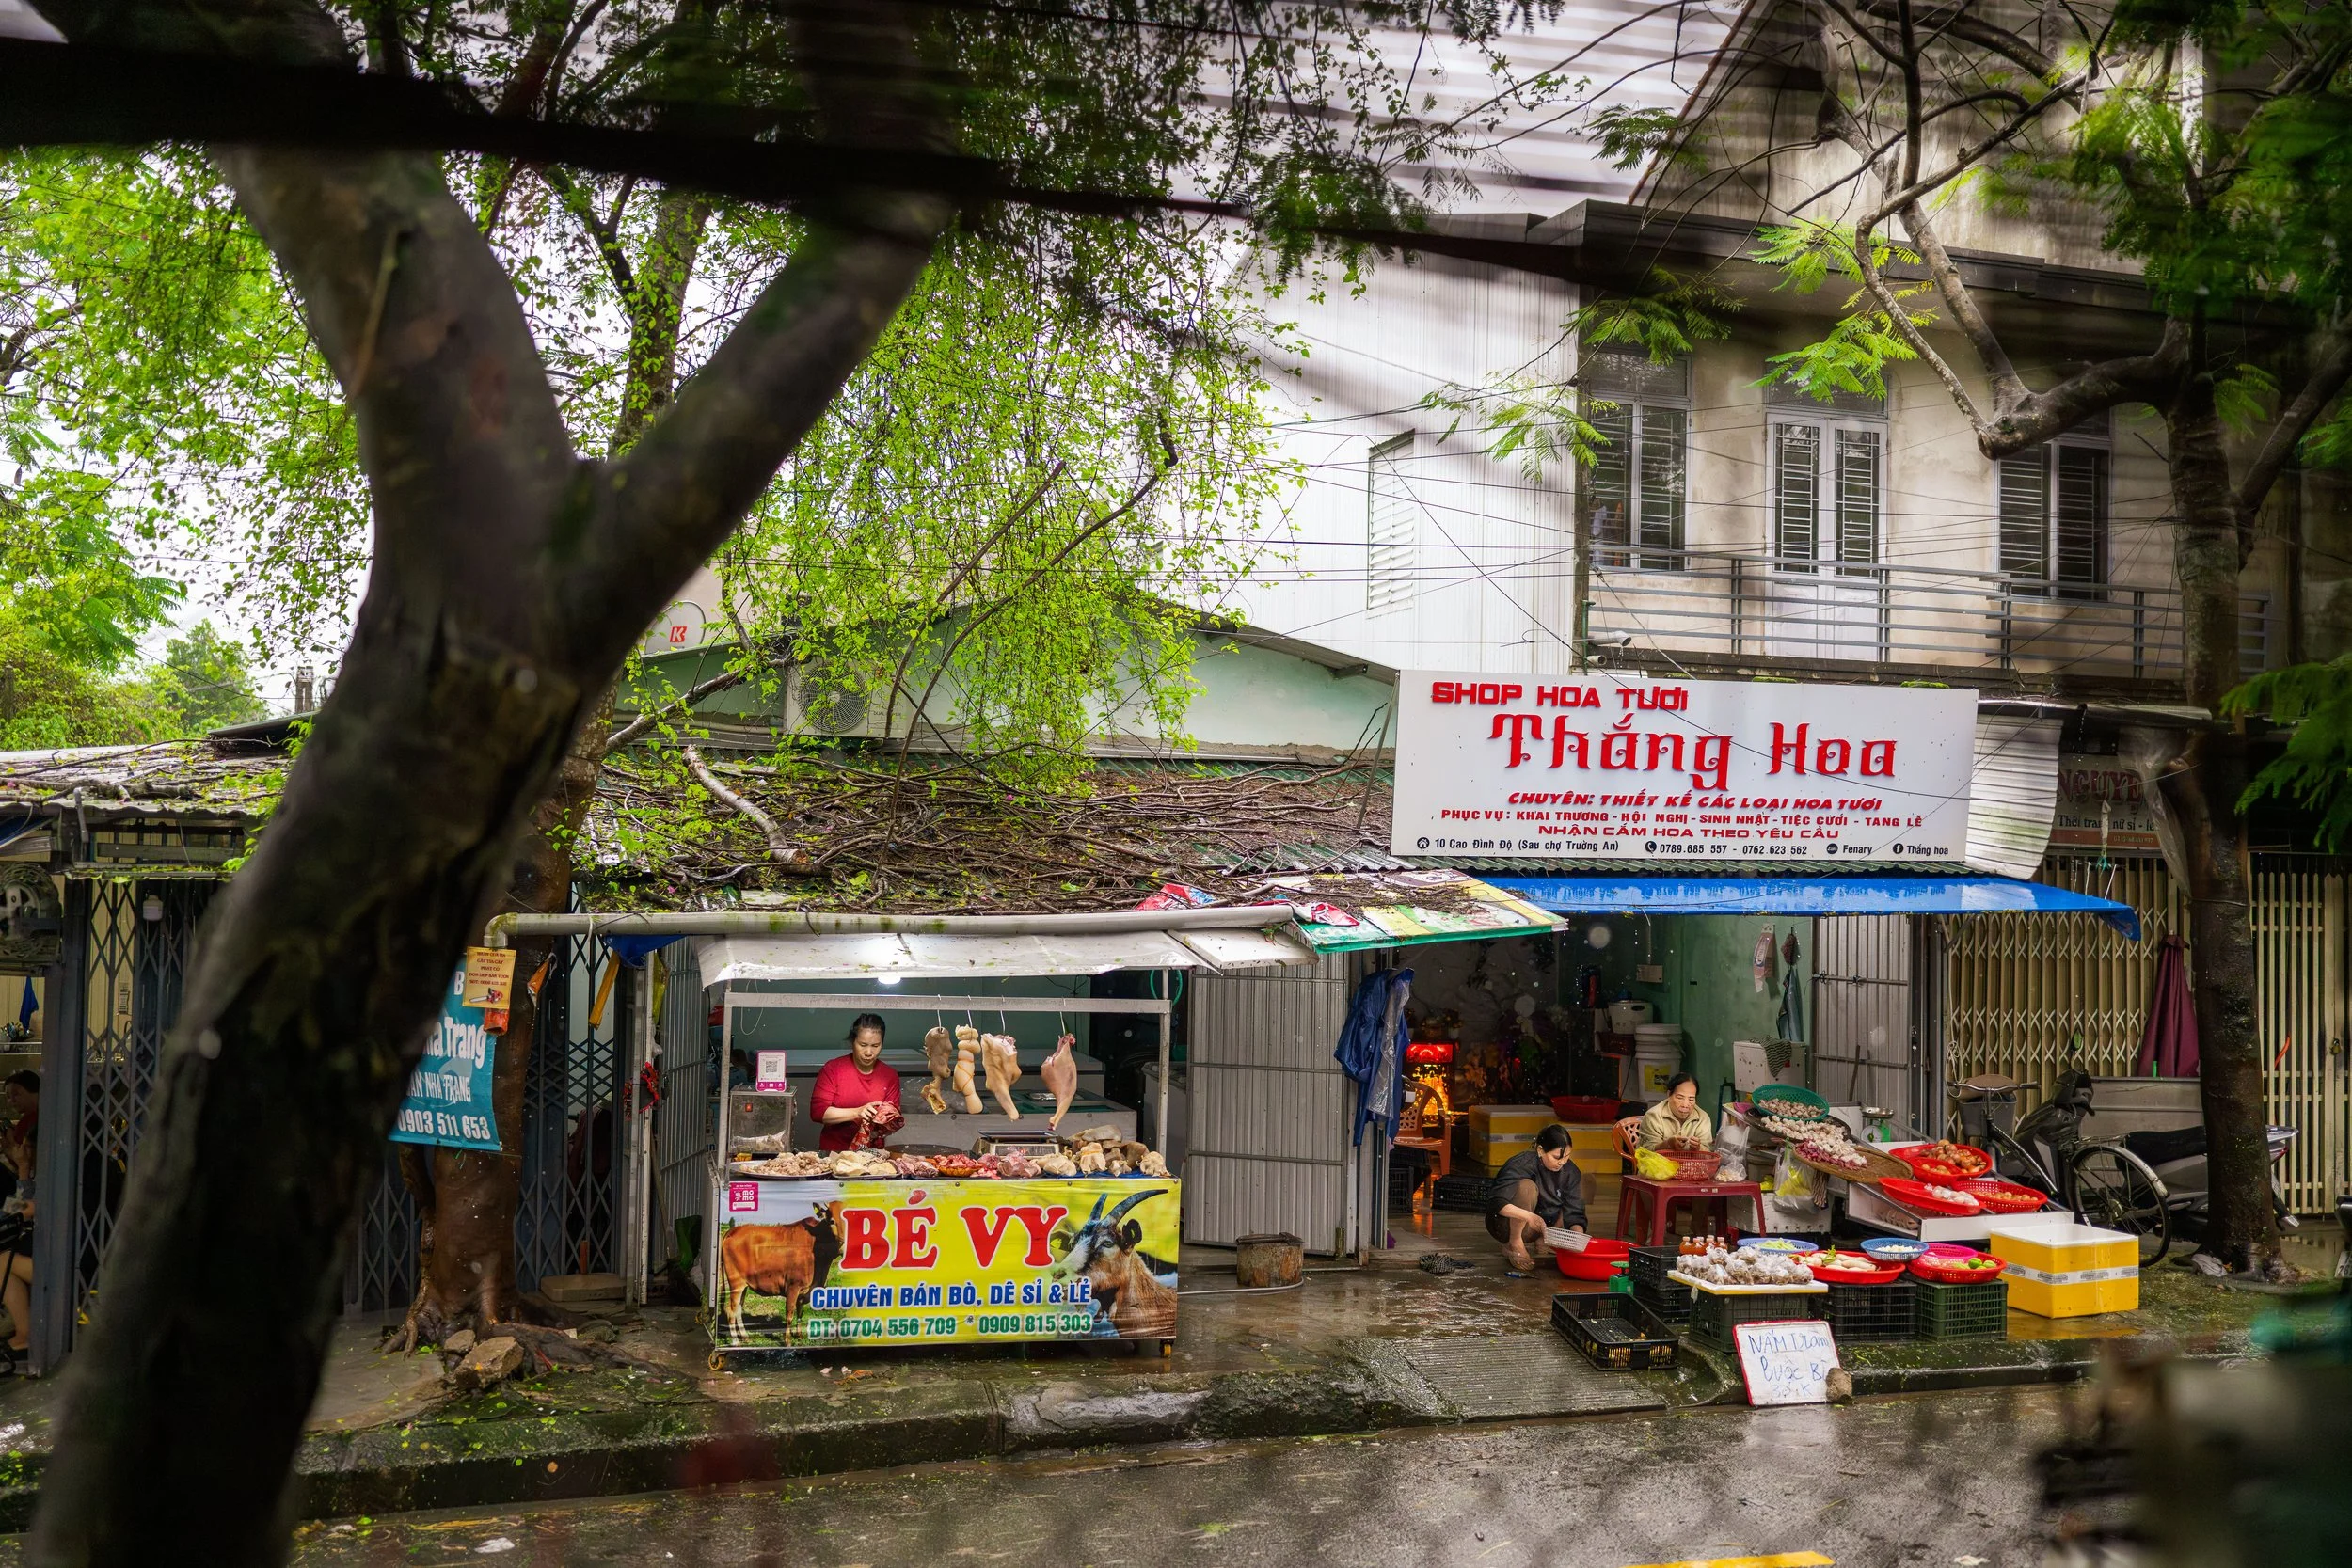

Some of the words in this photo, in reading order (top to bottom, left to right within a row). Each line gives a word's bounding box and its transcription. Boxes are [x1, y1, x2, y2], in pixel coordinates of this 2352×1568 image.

[1432, 682, 1522, 704] SHOP
[1536, 686, 1601, 707] HOA
[1616, 686, 1688, 710] TƯƠI
[1487, 712, 1733, 792] Thắng
[1766, 722, 1897, 777] Hoa
[1508, 791, 1596, 805] CHUYÊN:
[1600, 788, 1659, 806] THIẾT
[1664, 790, 1692, 807] KẾ
[1698, 794, 1736, 808] CÁC
[1740, 797, 1788, 811] LOẠI
[1792, 799, 1833, 809] HOA
[1838, 798, 1883, 810] TƯƠI
[1441, 810, 1480, 821] PHỤC
[1517, 812, 1549, 820] KHAI
[1555, 812, 1609, 821] TRƯƠNG
[1621, 811, 1646, 823] HỘI
[1656, 814, 1688, 824] NGHỊ
[1700, 814, 1730, 823] SINH
[1736, 813, 1770, 825] NHẬT
[1781, 815, 1810, 825] TIỆC
[1817, 814, 1848, 825] CƯỚI
[1866, 817, 1899, 826] TANG
[1907, 816, 1922, 827] LỄ
[1539, 824, 1597, 836] NHẬN
[1653, 828, 1693, 837] HOA
[1700, 829, 1749, 838] THEO
[1756, 828, 1793, 838] YÊU
[1801, 826, 1839, 838] CẦU
[1435, 839, 1446, 847] 10
[1450, 839, 1468, 848] Cao
[1473, 839, 1494, 849] Đình
[1500, 839, 1512, 850] Độ
[1518, 839, 1540, 850] (Sau
[1545, 841, 1562, 851] chợ
[1566, 841, 1598, 851] Trường
[1602, 841, 1618, 851] An)
[1660, 844, 1704, 854] 0789.685
[1710, 845, 1727, 854] 557
[1843, 845, 1872, 855] Fenary
[1907, 844, 1931, 856] Thắng
[1934, 846, 1948, 855] hoa
[444, 1016, 487, 1069] Trang
[437, 1112, 460, 1137] 511
[461, 1115, 491, 1140] 653
[840, 1189, 938, 1268] BÉ
[960, 1206, 1068, 1268] VY
[812, 1284, 893, 1308] CHUYÊN
[900, 1282, 942, 1306] BÁN
[948, 1281, 982, 1306] BÒ,
[990, 1280, 1015, 1304] DÊ
[1022, 1278, 1042, 1304] SỈ
[1048, 1284, 1064, 1304] &
[1069, 1278, 1091, 1303] LẺ
[809, 1320, 835, 1338] ĐT:
[840, 1319, 882, 1338] 0704
[887, 1318, 919, 1336] 556
[925, 1317, 956, 1335] 709
[978, 1315, 1020, 1334] 0909
[1025, 1314, 1056, 1333] 815
[1060, 1314, 1091, 1332] 303
